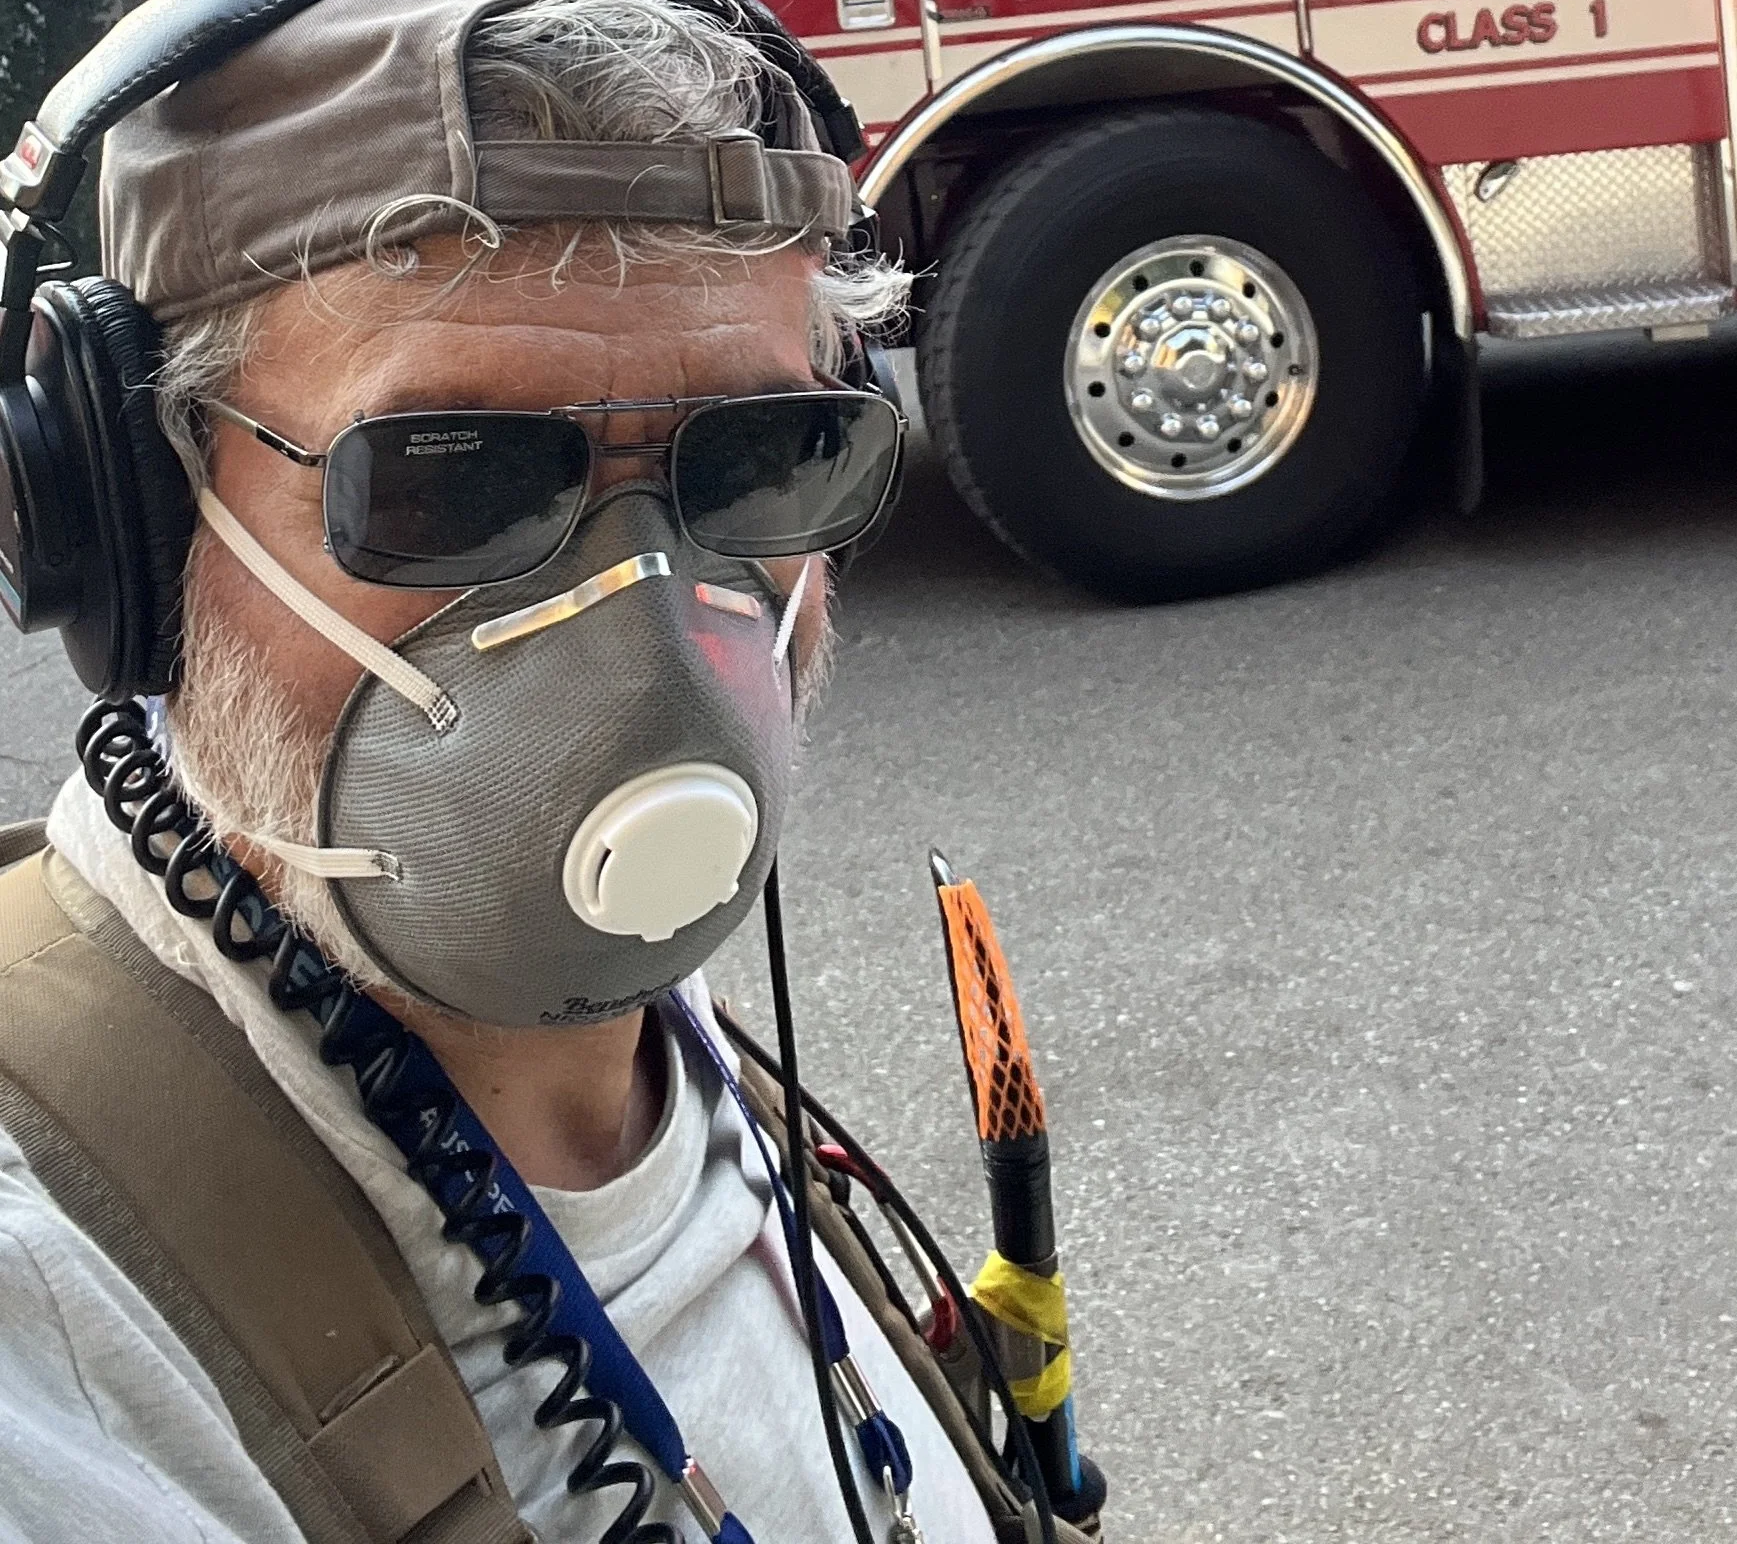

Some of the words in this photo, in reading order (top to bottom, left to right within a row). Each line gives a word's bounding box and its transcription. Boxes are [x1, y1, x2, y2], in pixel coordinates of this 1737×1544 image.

[1416, 0, 1559, 54] CLASS
[410, 430, 477, 443] SCRATCH
[406, 441, 483, 455] RESISTANT
